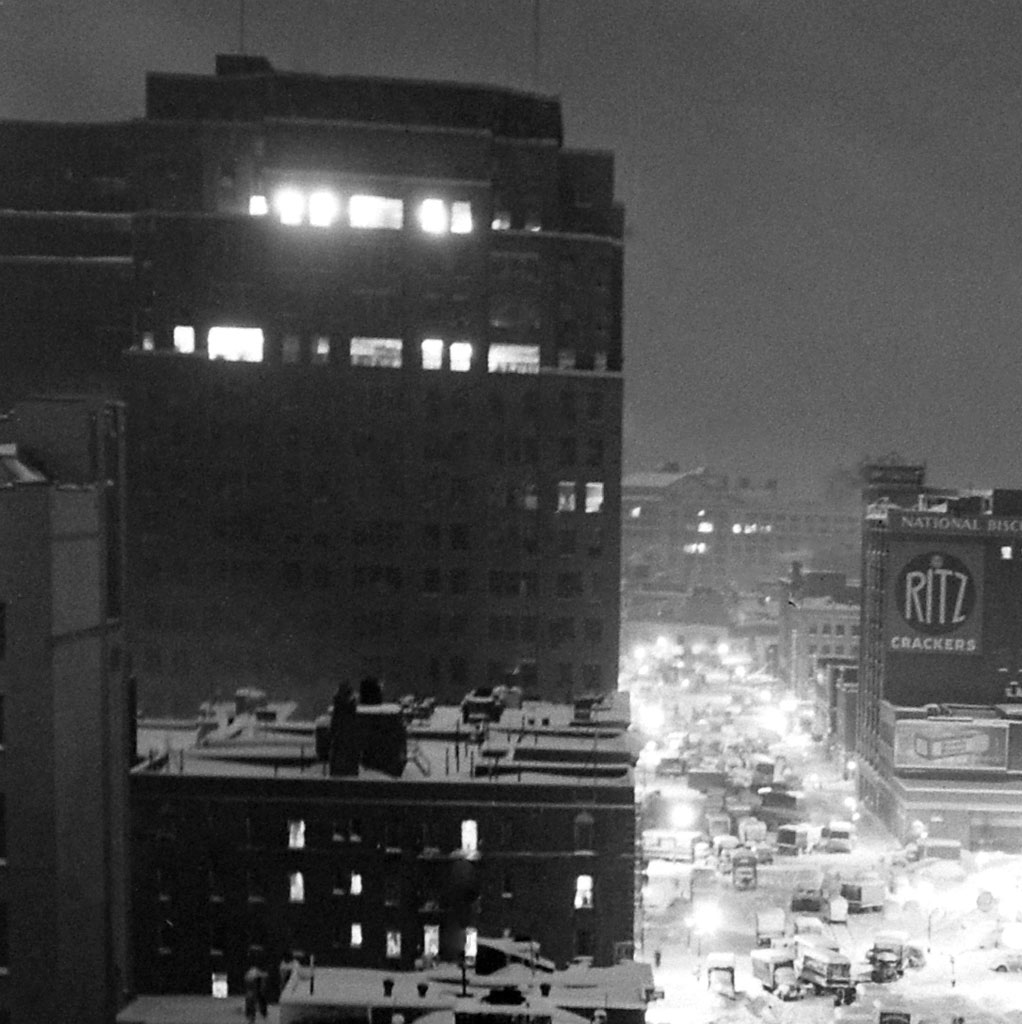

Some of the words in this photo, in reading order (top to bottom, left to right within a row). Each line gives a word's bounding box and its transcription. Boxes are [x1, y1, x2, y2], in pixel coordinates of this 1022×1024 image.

[901, 515, 980, 531] NATIONAL
[905, 567, 969, 624] RITZ
[891, 636, 977, 652] CRACKERS
